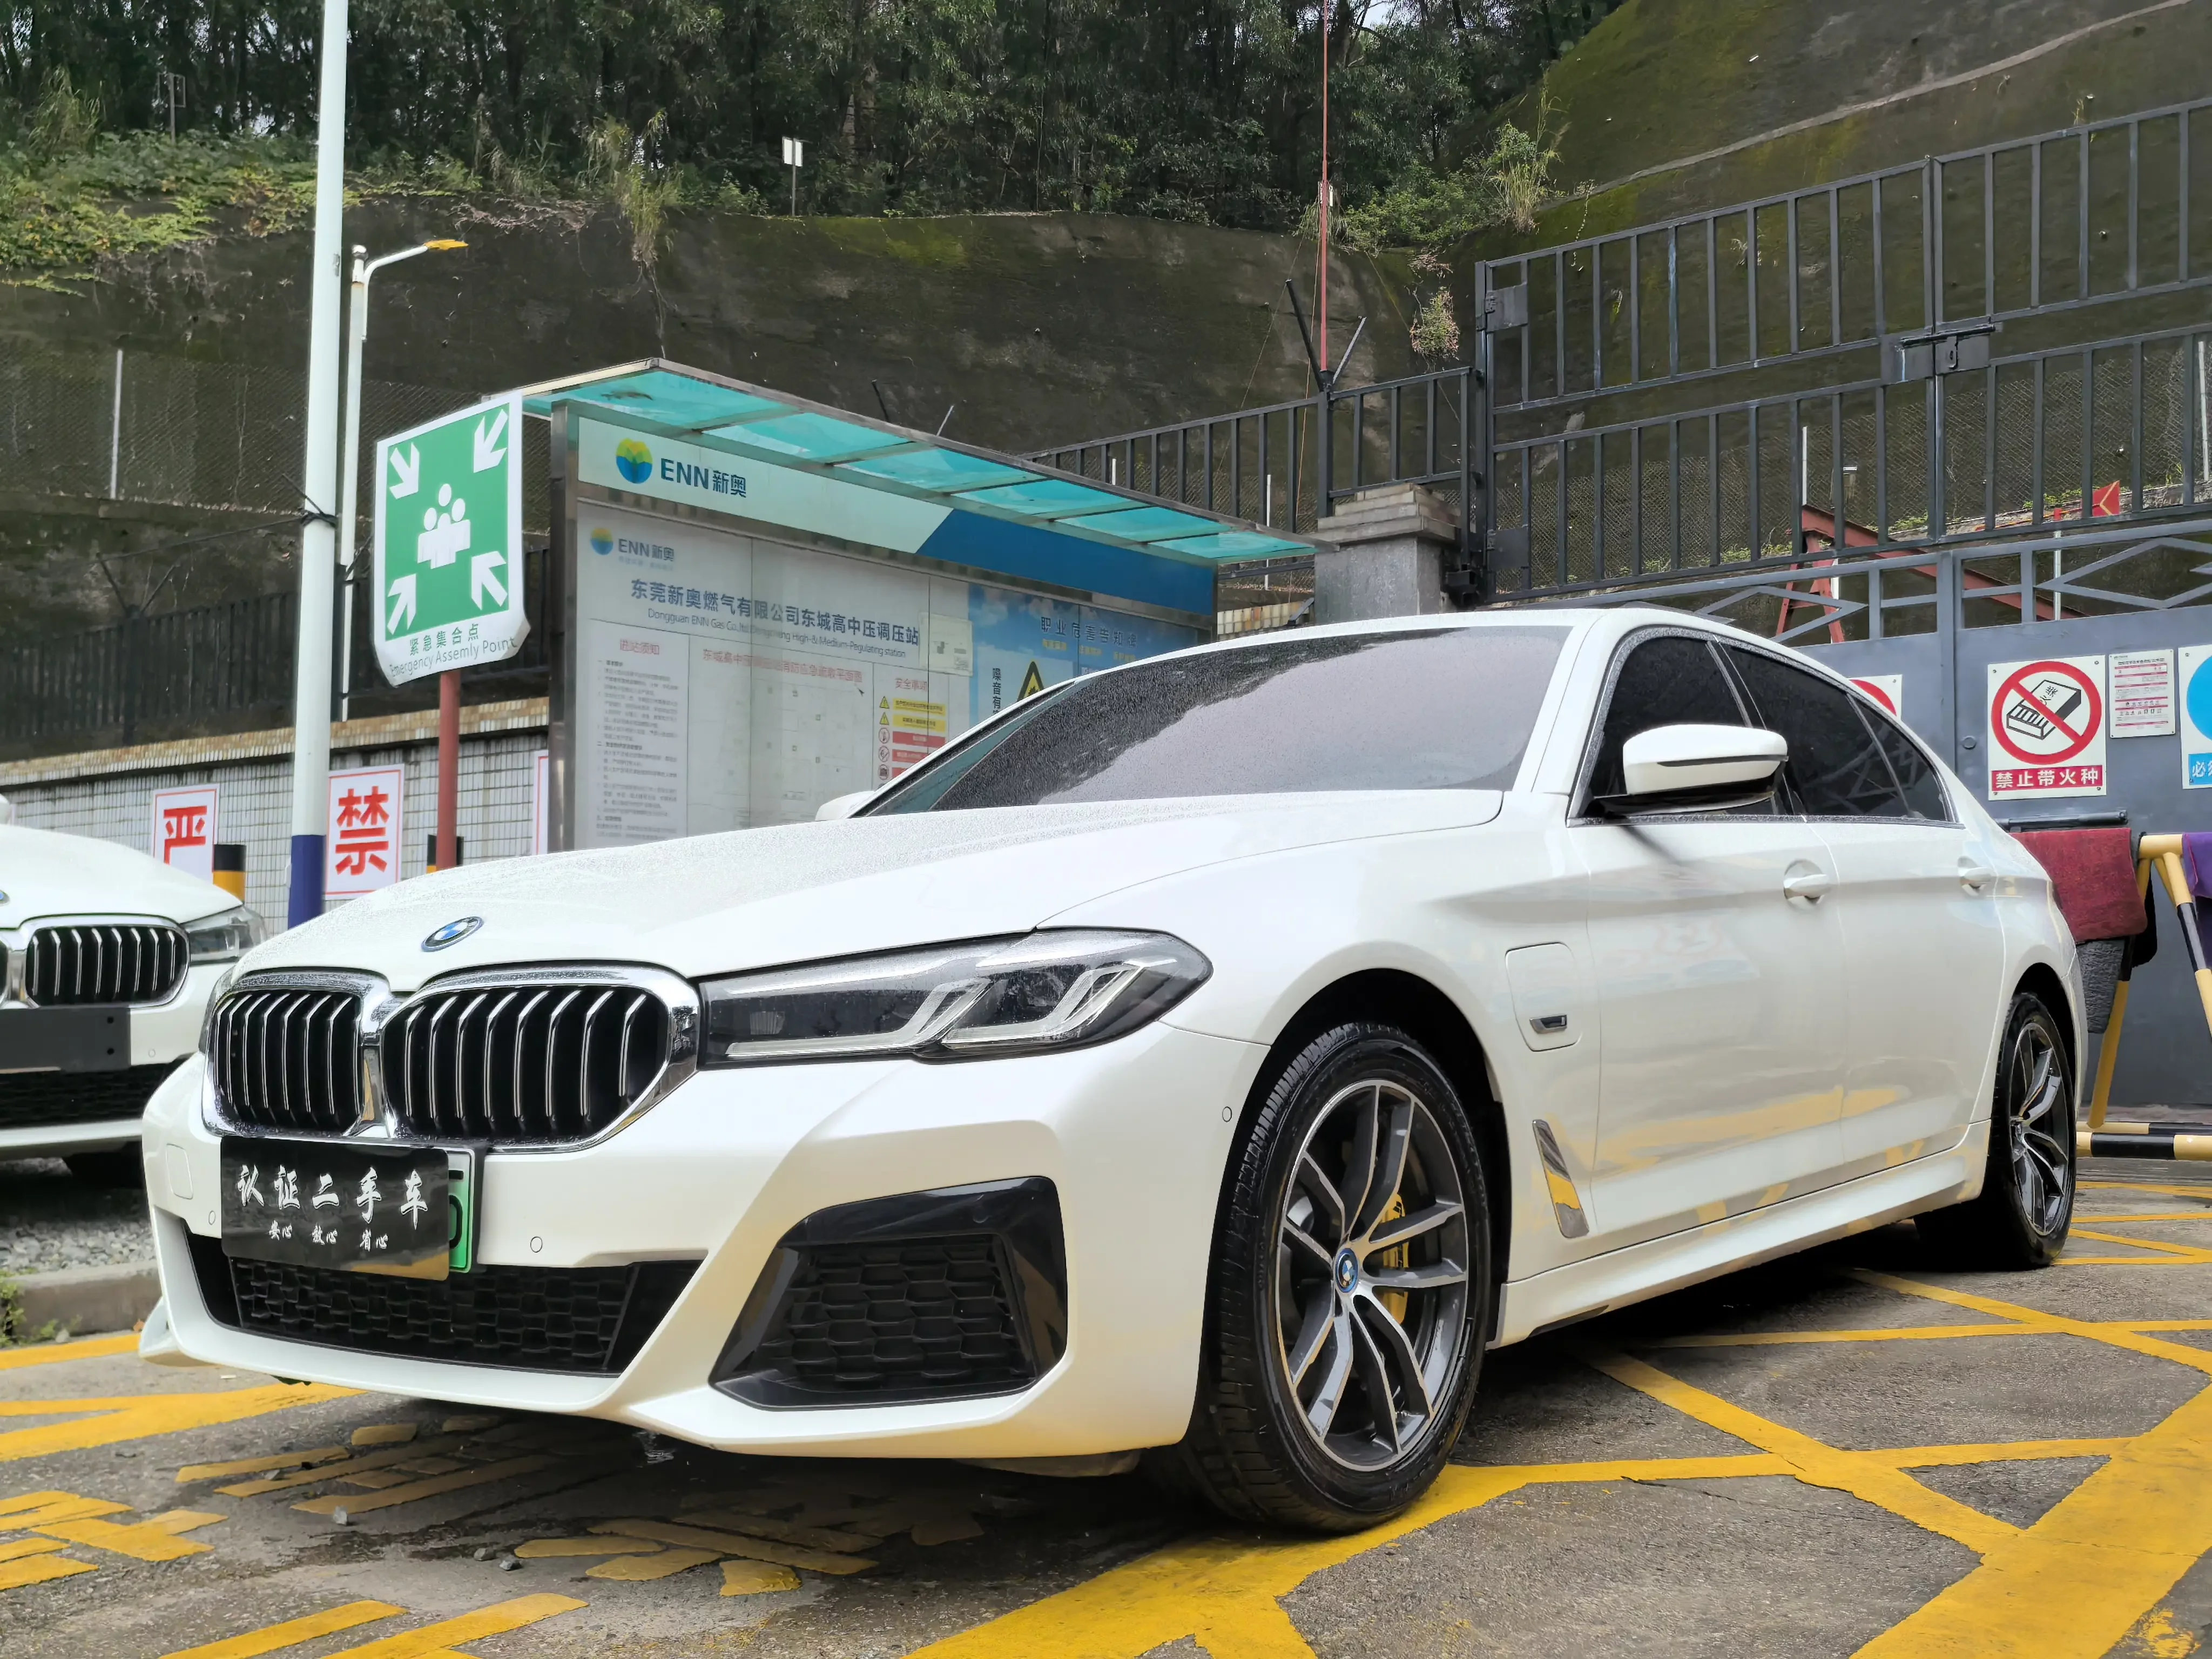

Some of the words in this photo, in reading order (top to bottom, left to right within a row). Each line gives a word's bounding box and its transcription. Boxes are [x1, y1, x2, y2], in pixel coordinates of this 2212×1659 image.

[630, 578, 919, 646] 东莞新奥燃气有限公司东城高中压调压站
[648, 608, 689, 625] Dongguan
[691, 615, 709, 626] ENN
[711, 618, 724, 630] Gas
[884, 648, 906, 658] station
[389, 654, 434, 677] Emergency
[435, 643, 481, 664] Assemly
[482, 636, 518, 653] Point
[409, 623, 479, 656] 紧急集合点
[1995, 767, 2099, 788] 禁止带火种
[163, 805, 208, 865] 严
[335, 785, 390, 876] 禁
[237, 1164, 429, 1230] 认证二手车
[312, 1223, 338, 1245] 放心
[360, 1229, 389, 1252] 省心
